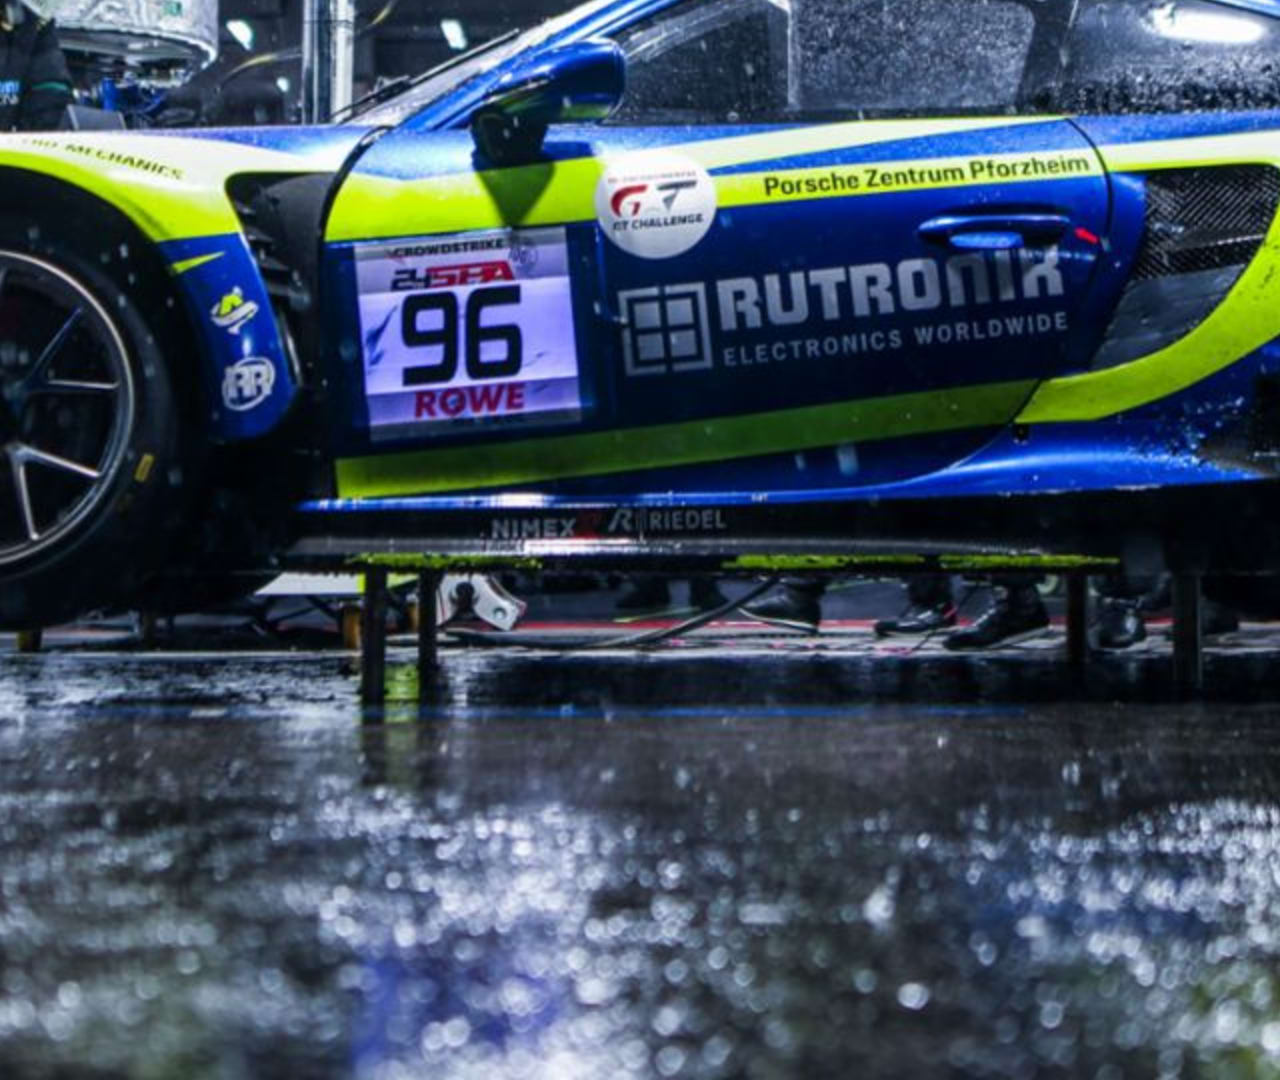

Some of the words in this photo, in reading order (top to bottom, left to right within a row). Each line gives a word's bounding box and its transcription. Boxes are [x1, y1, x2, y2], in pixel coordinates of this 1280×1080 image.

[764, 170, 860, 197] Porsche
[866, 164, 965, 189] Zentrum
[969, 154, 1090, 180] Pforzheim
[631, 213, 705, 231] CHALLENGE
[392, 237, 506, 258] CROWDSTRIKE
[400, 283, 524, 387] 96
[722, 330, 904, 368] ELECTRONICS
[914, 311, 1069, 346] WORLDWIDE
[414, 383, 526, 419] ROWE
[649, 508, 727, 532] RIEDEL
